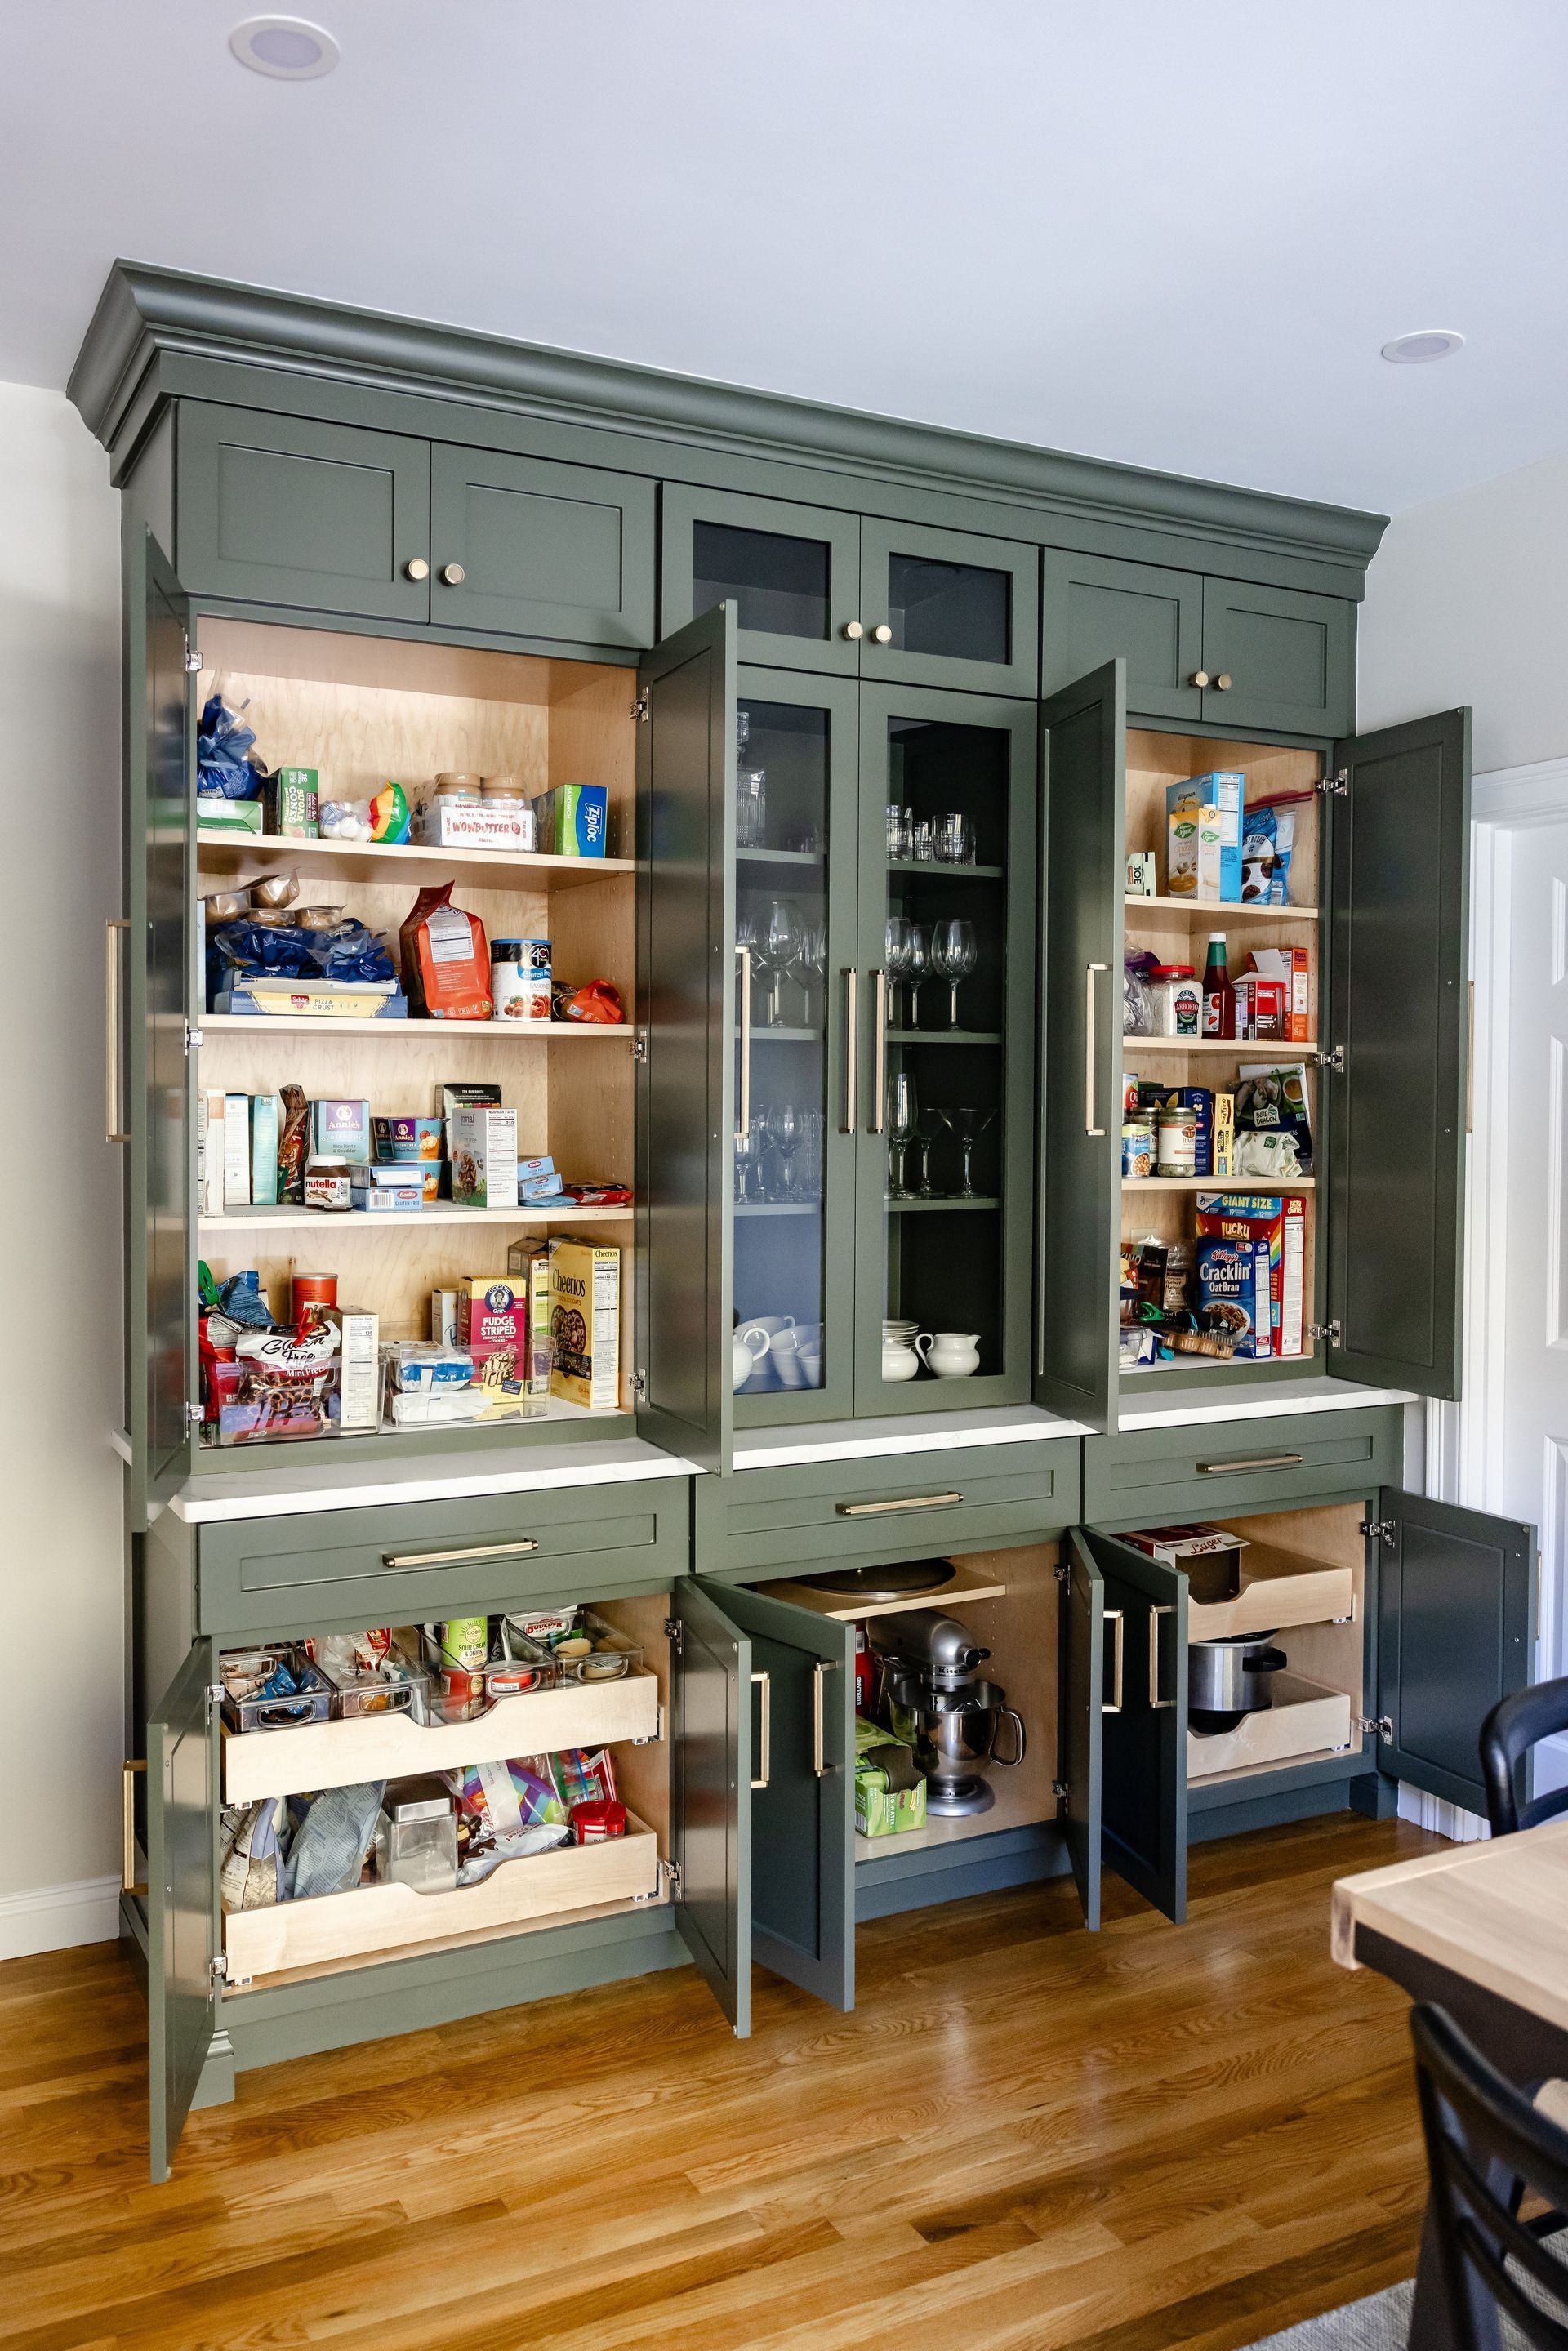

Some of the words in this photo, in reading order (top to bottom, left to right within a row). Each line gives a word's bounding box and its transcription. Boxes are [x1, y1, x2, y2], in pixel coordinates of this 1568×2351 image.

[301, 772, 308, 783] 12
[287, 786, 297, 823] CONES
[296, 788, 305, 822] SUGAR
[585, 806, 600, 843] Ziploc
[1134, 866, 1142, 884] JOE
[531, 947, 546, 966] 4C
[523, 969, 544, 978] Gluten
[1256, 1111, 1267, 1119] BLUE
[1256, 1116, 1276, 1125] DRAGON
[328, 1120, 360, 1129] Annie's
[305, 1179, 336, 1188] nutella
[1222, 1196, 1251, 1207] GIANT
[1251, 1197, 1272, 1209] SIZE
[1211, 1249, 1239, 1264] Kellogg's
[1200, 1262, 1252, 1281] Cracklin'
[552, 1268, 586, 1297] Cheerios
[488, 1284, 511, 1293] GOODIE
[483, 1316, 514, 1326] FUDGE
[480, 1325, 516, 1336] STRIPED
[282, 1349, 316, 1364] Free
[286, 1369, 305, 1377] Mini
[1191, 1537, 1223, 1555] Lager
[526, 1622, 563, 1633] BOULDER
[473, 1641, 486, 1650] CREAM
